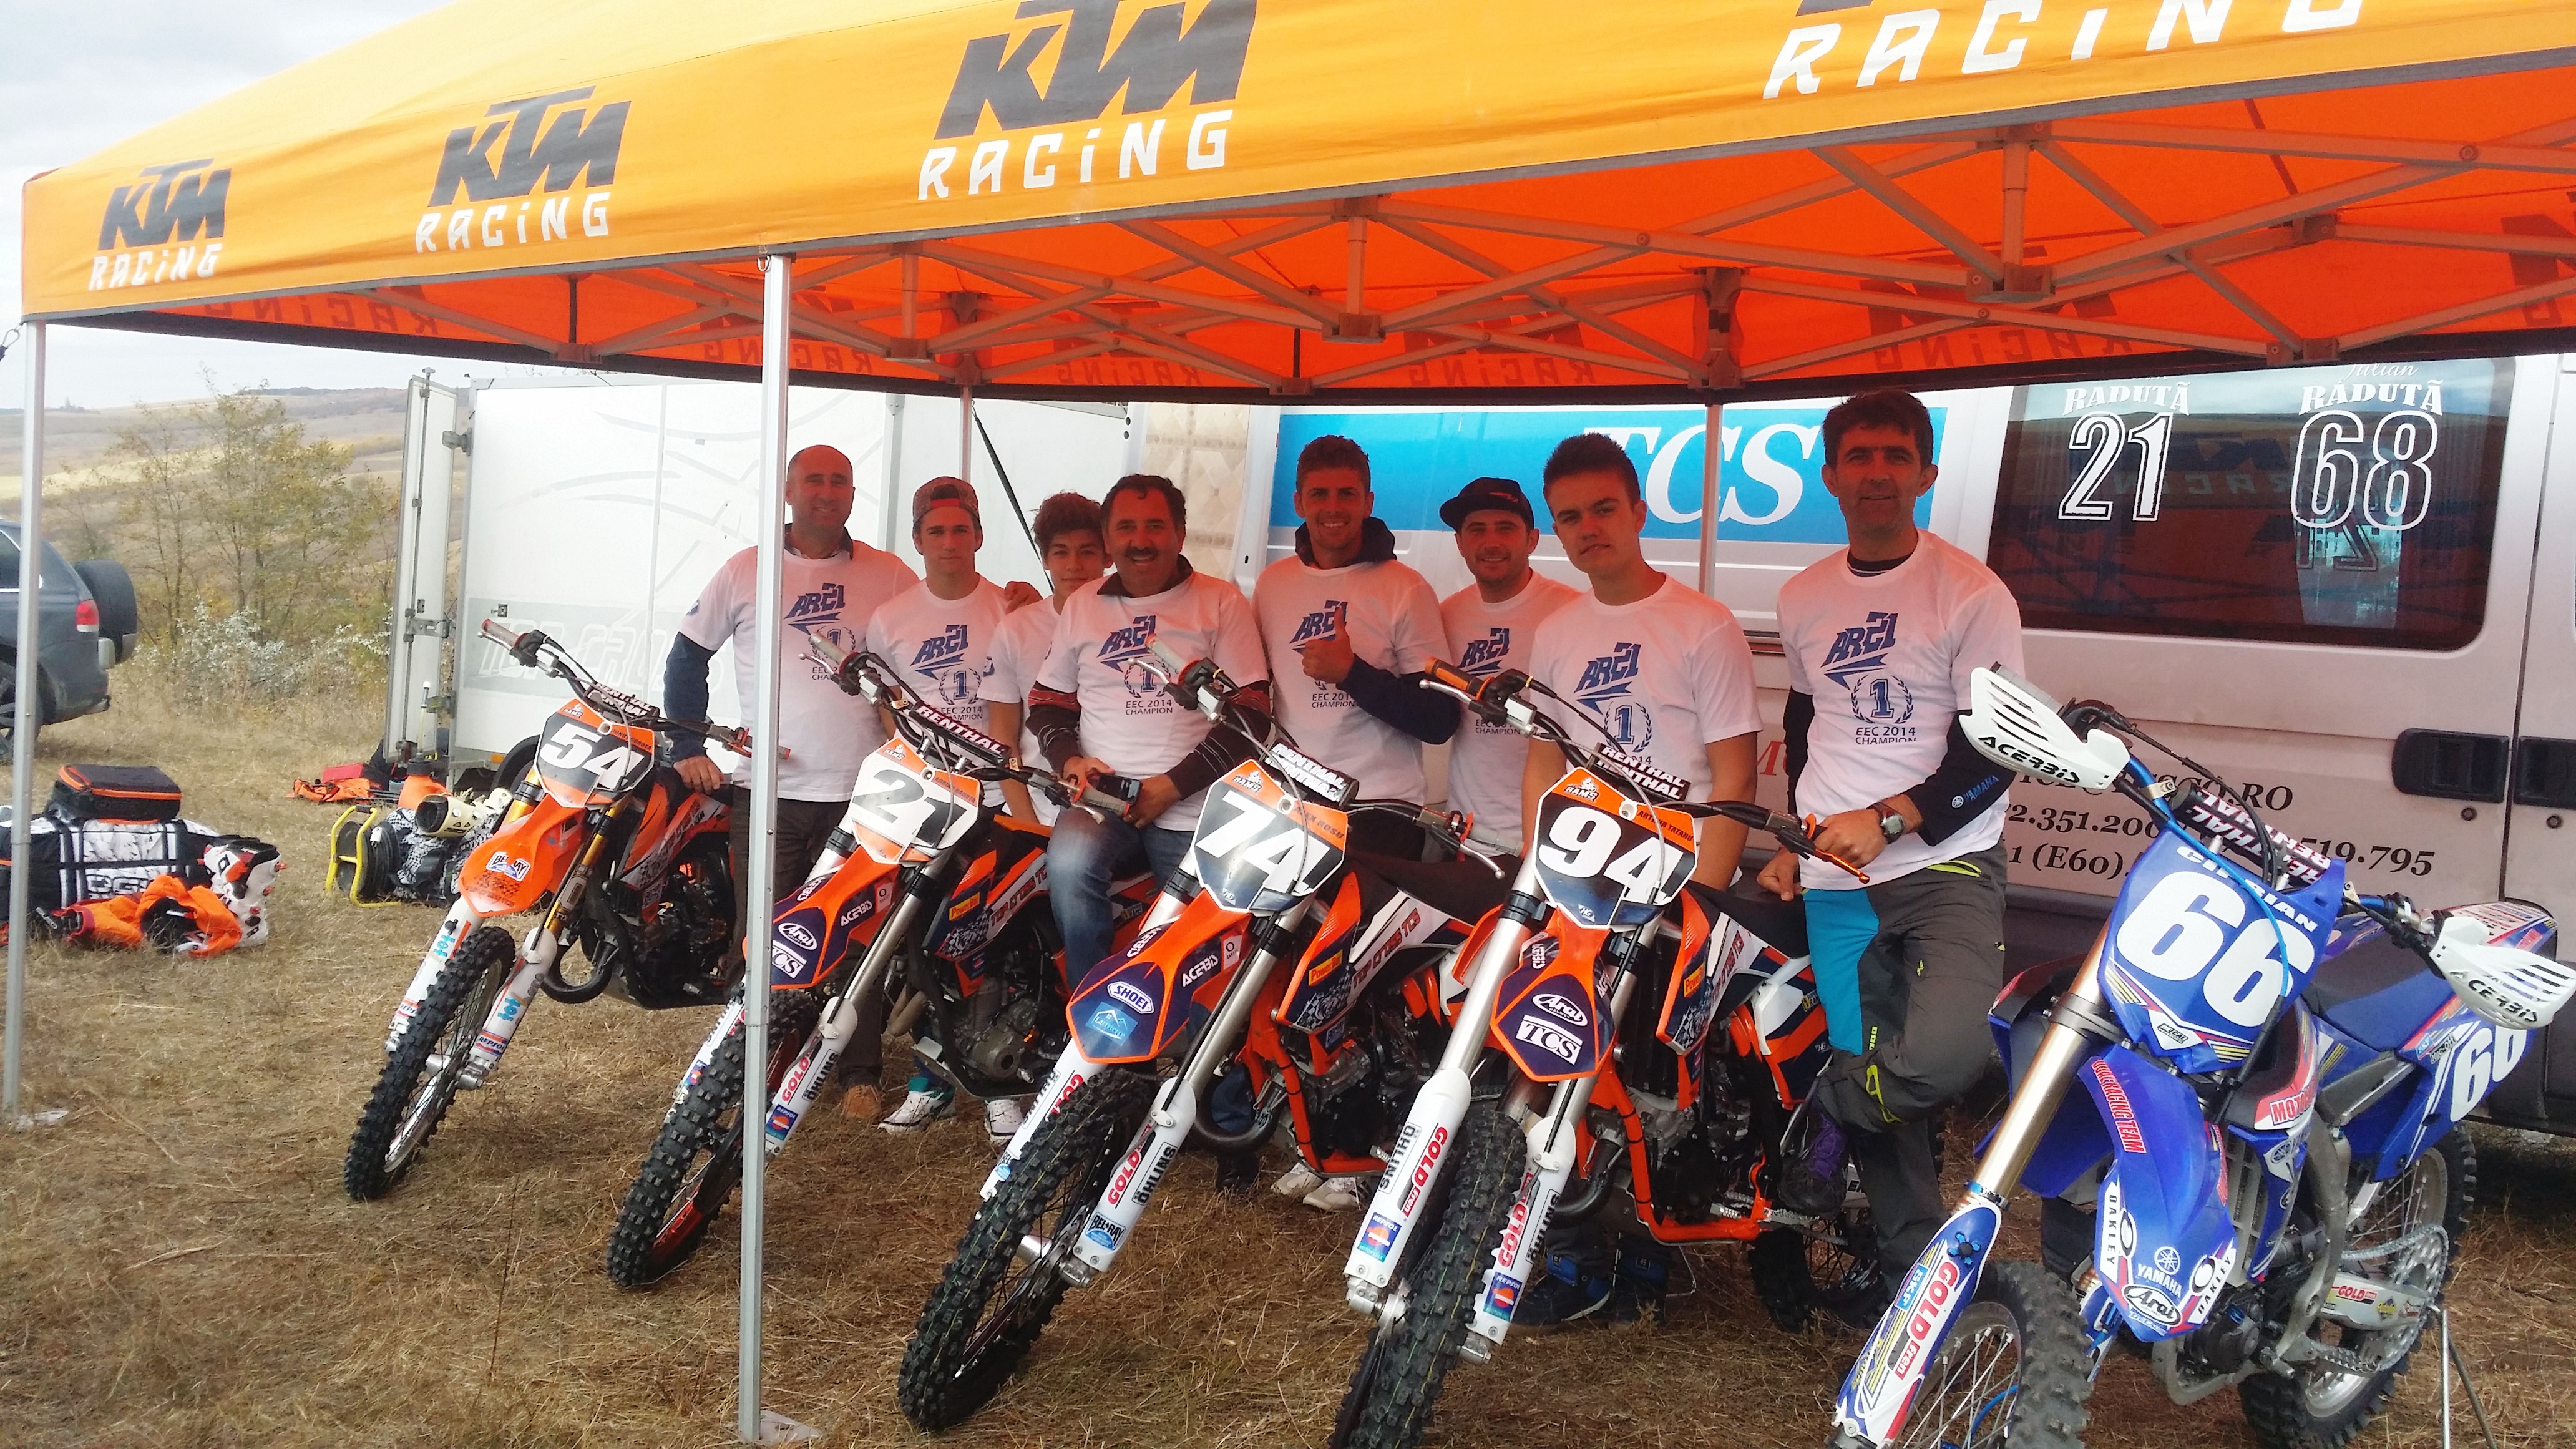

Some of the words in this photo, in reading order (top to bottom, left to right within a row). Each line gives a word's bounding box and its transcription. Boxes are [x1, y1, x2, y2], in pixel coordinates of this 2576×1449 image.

[934, 0, 1256, 140] KTM
[427, 85, 632, 207] KTM
[97, 158, 232, 250] KTM
[2057, 411, 2174, 522] 21
[2290, 409, 2438, 530] 68
[953, 670, 970, 700] 1
[1126, 700, 1144, 708] EEC
[1147, 699, 1173, 707] 2014
[1312, 700, 1355, 708] CHAMPION
[1870, 678, 1895, 719] 1
[564, 708, 583, 718] RAMS
[917, 705, 1003, 754] RENTHAL
[1125, 707, 1173, 715] CHAMPION
[1614, 705, 1634, 745] 1
[1855, 727, 1879, 736] EEC
[1883, 726, 1916, 736] 2014
[539, 722, 645, 790] 54
[883, 748, 905, 760] RAMS
[1855, 737, 1916, 745] CHAMPION
[1233, 775, 1262, 793] RAMS
[1272, 743, 1346, 790] RENTHAL
[1600, 746, 1686, 788] RENTHAL
[852, 769, 968, 847] 21
[1564, 785, 1599, 803] RAMS
[1195, 788, 1331, 896] 74
[1538, 806, 1684, 904] 94
[1401, 907, 1422, 937] TCS
[2116, 871, 2315, 1028] 66
[1114, 985, 1149, 1010] SHOEI
[1538, 995, 1583, 1022] Arai
[1522, 1023, 1578, 1060] TCS
[781, 1055, 811, 1102] GOLD
[1413, 1126, 1448, 1187] GOLD
[2115, 1119, 2147, 1154] TEAM
[1107, 1150, 1142, 1205] GOLD
[1372, 1214, 1398, 1232] REPSOL
[1498, 1203, 1530, 1268] GOLD
[2106, 1194, 2118, 1266] OAKLEY
[2137, 1262, 2183, 1299] YAMAHA
[2197, 1256, 2232, 1315] OAKLEY
[2338, 1285, 2366, 1300] GOLD
[1910, 1261, 1959, 1342] GOLD
[2127, 1289, 2175, 1320] Arai
[1896, 1340, 1920, 1380] fren
